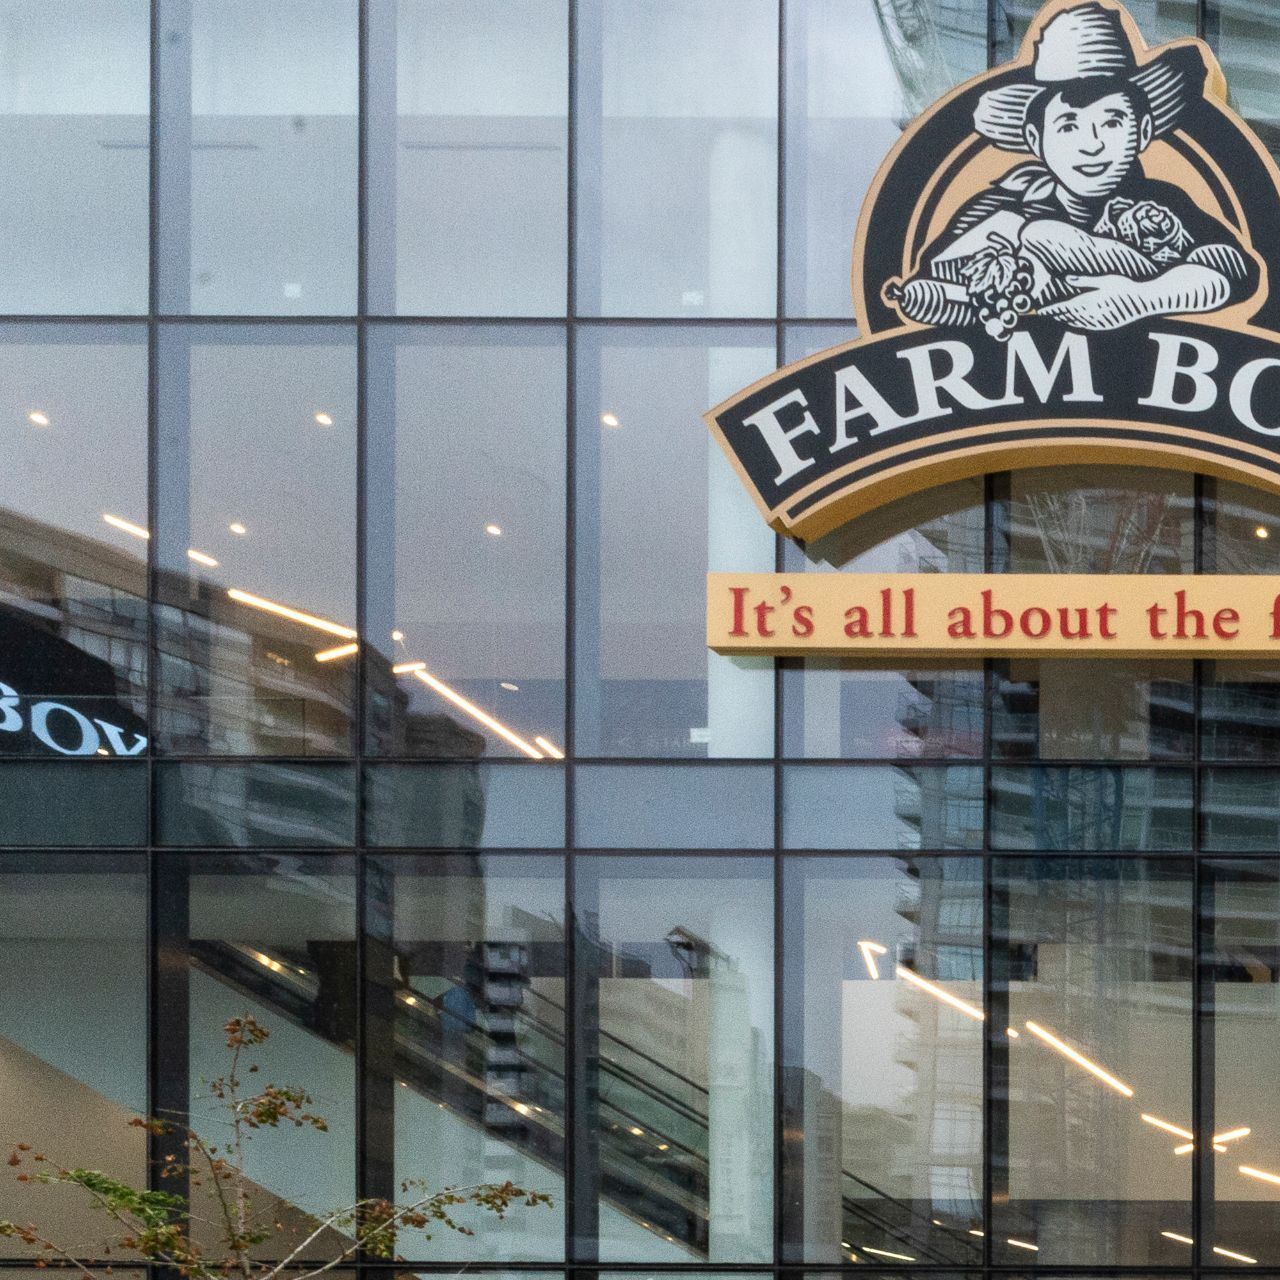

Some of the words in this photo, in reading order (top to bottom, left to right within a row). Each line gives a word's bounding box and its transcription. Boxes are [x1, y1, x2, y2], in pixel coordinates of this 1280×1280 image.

[743, 333, 1104, 487] FARM
[729, 587, 815, 639] It's
[845, 588, 916, 639] all
[946, 591, 1118, 640] about
[1148, 590, 1241, 640] the
